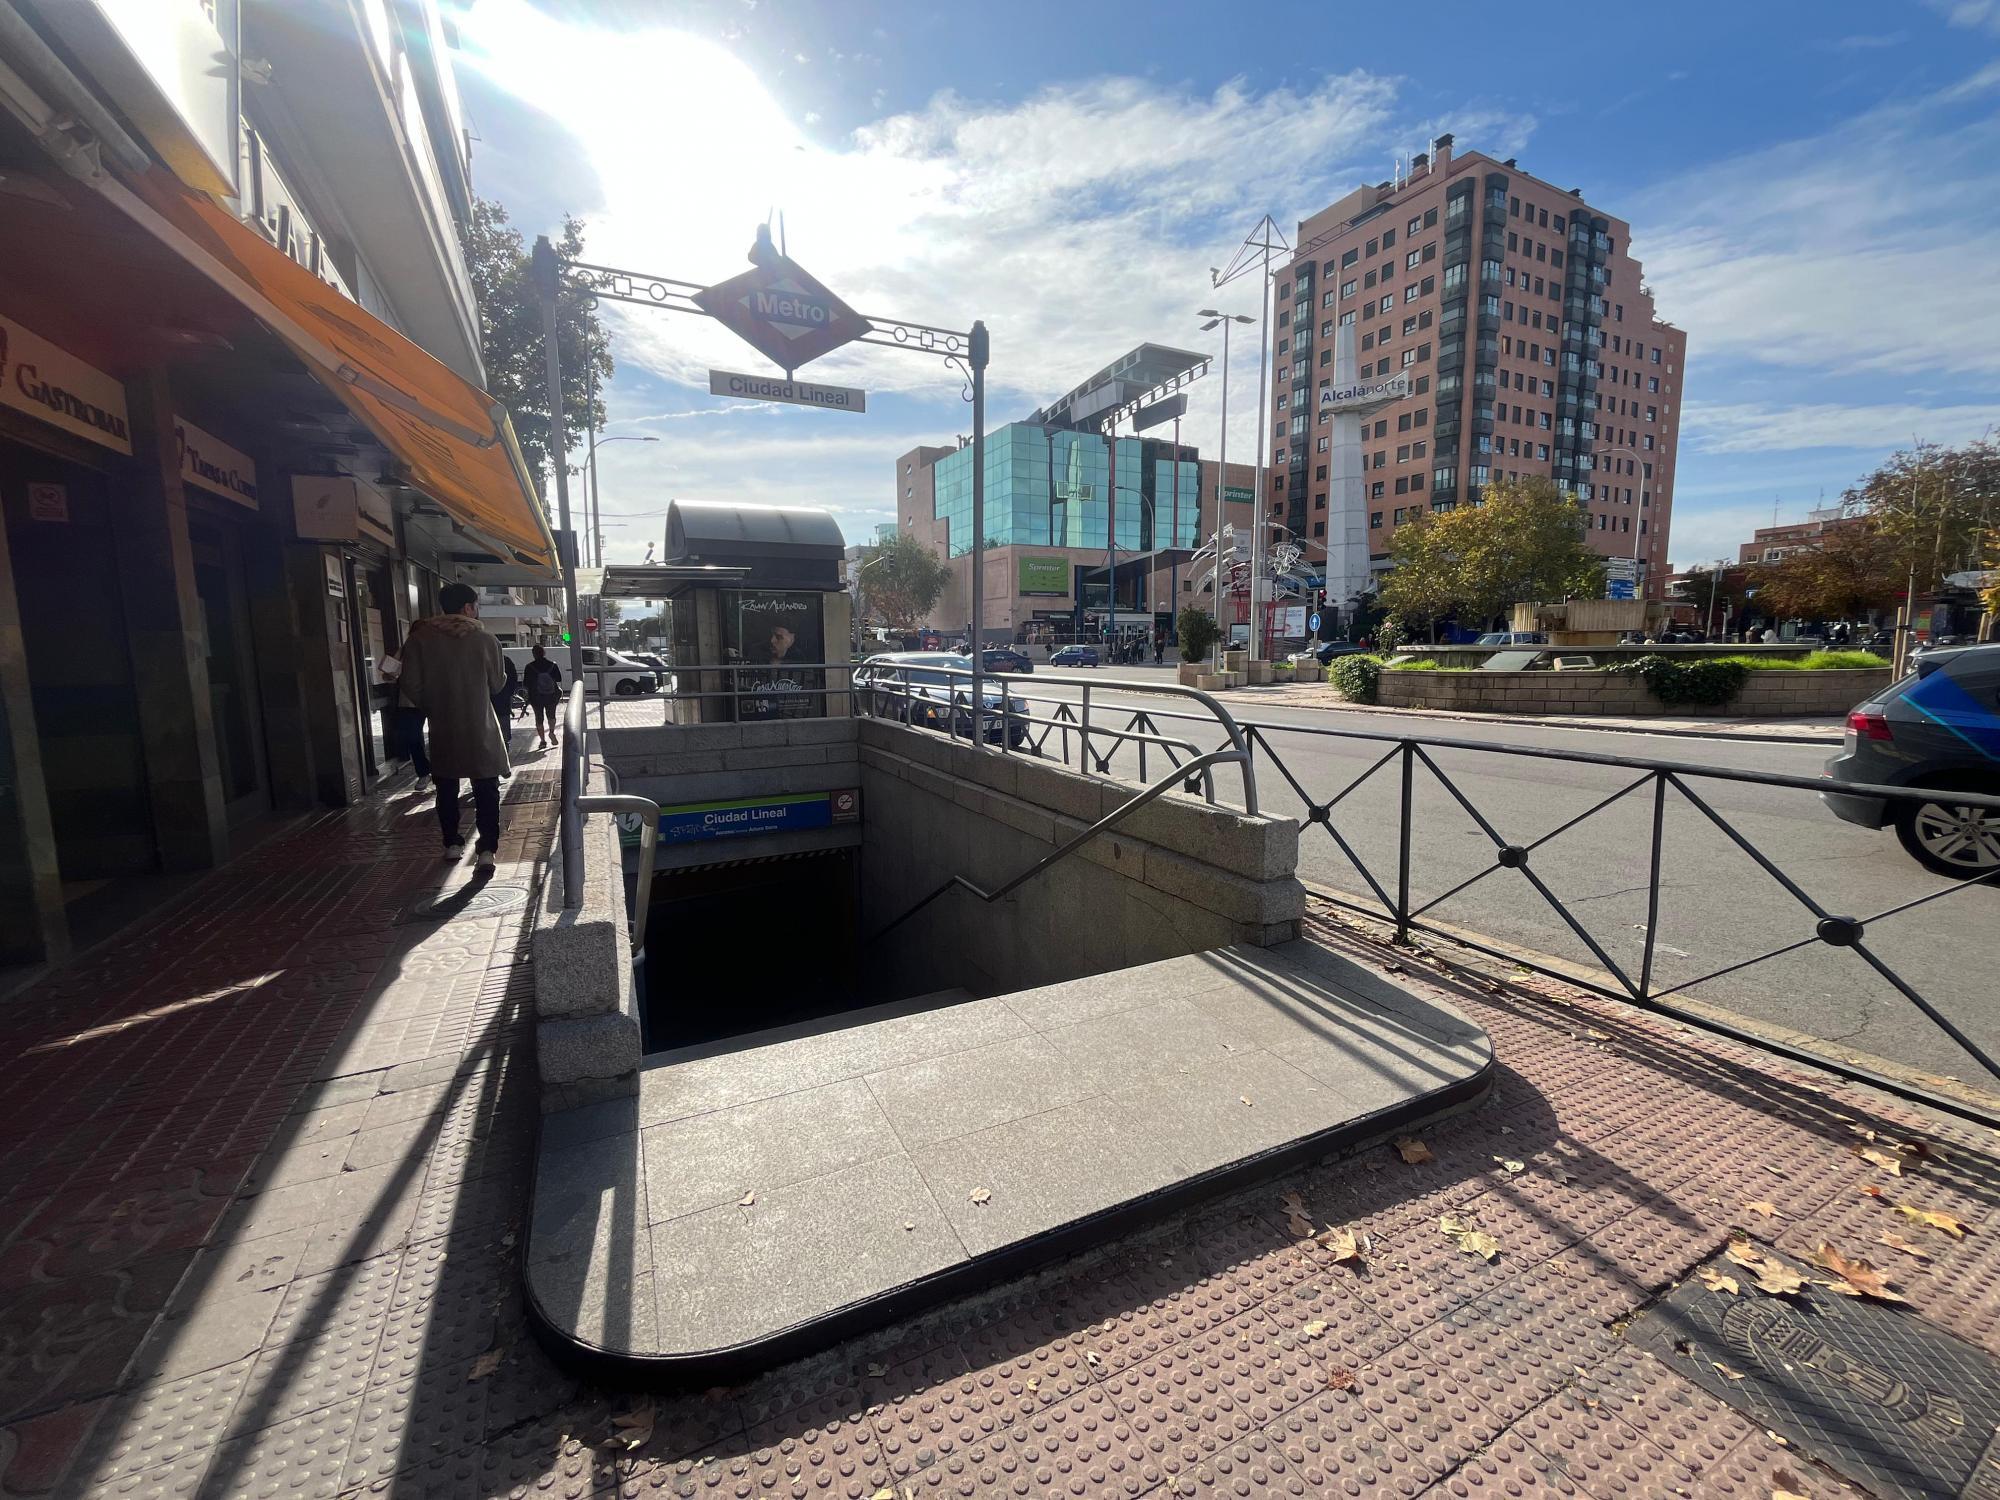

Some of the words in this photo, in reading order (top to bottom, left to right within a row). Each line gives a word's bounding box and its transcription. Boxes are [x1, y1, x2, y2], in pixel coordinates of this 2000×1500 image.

[756, 291, 825, 323] Metro
[728, 376, 794, 400] Ciudad
[799, 385, 850, 407] Lineal
[1218, 490, 1253, 500] printer
[704, 809, 748, 825] Ciudad
[751, 807, 787, 821] Lineal
